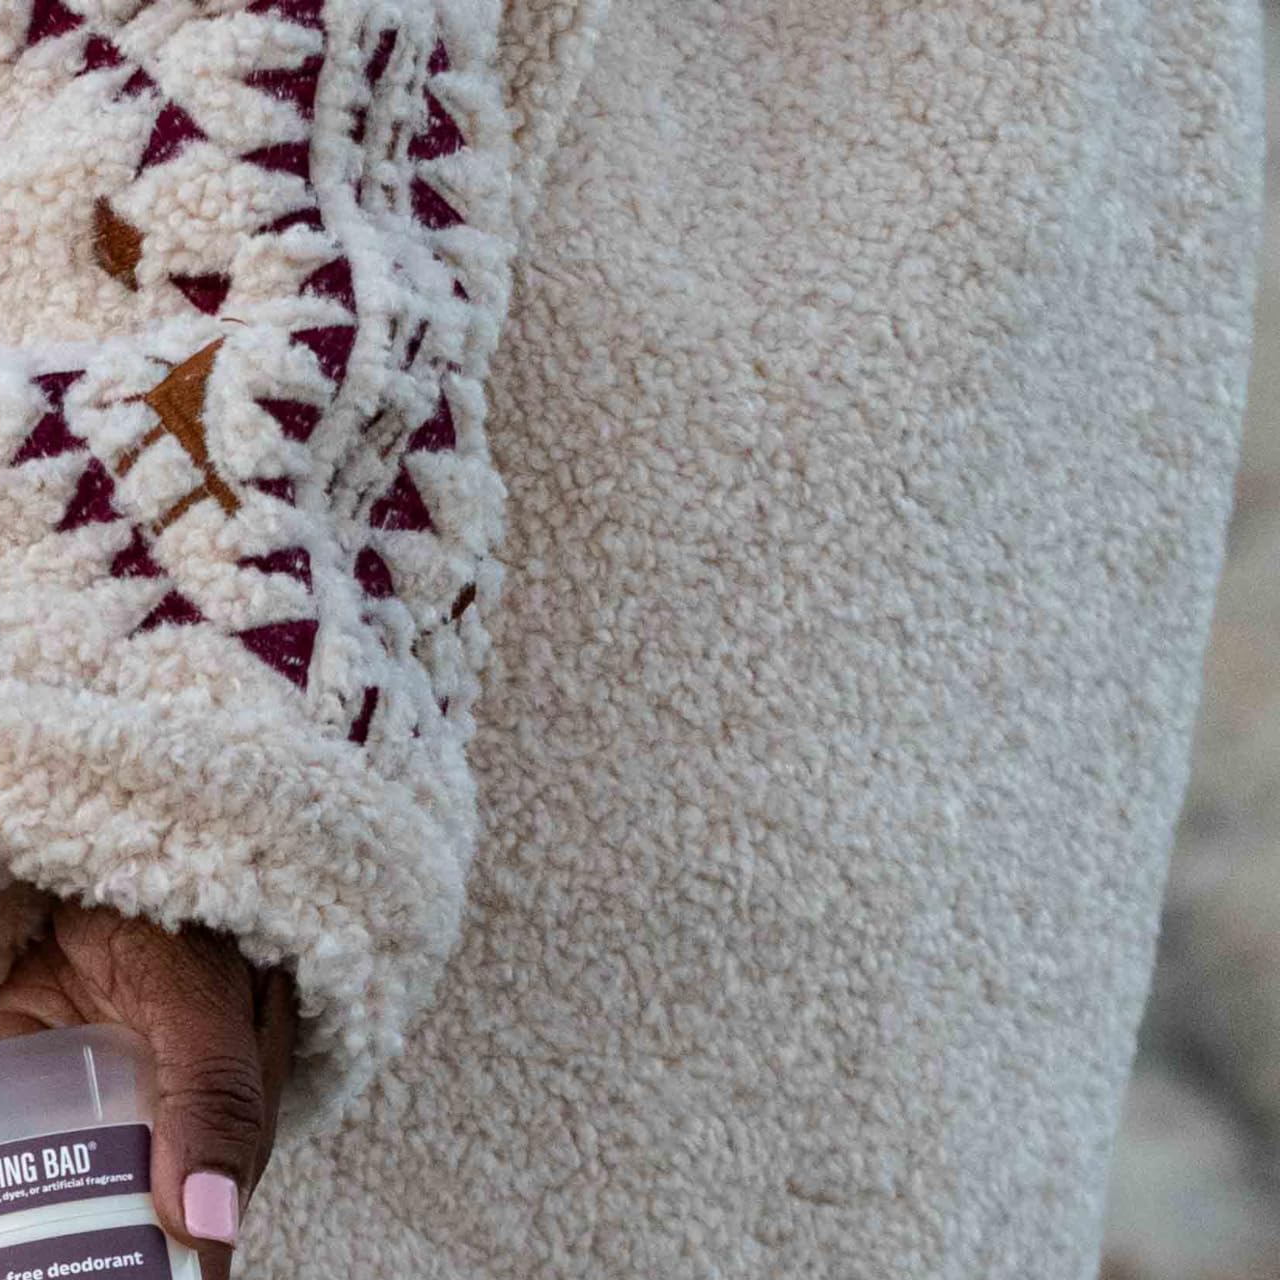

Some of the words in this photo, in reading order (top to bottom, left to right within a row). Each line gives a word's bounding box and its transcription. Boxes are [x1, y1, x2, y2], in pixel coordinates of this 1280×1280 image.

[2, 1188, 29, 1202] dyes,
[29, 1186, 40, 1195] or
[42, 1178, 84, 1192] artificial
[85, 1172, 133, 1186] fragrance
[47, 1251, 144, 1279] deodorant
